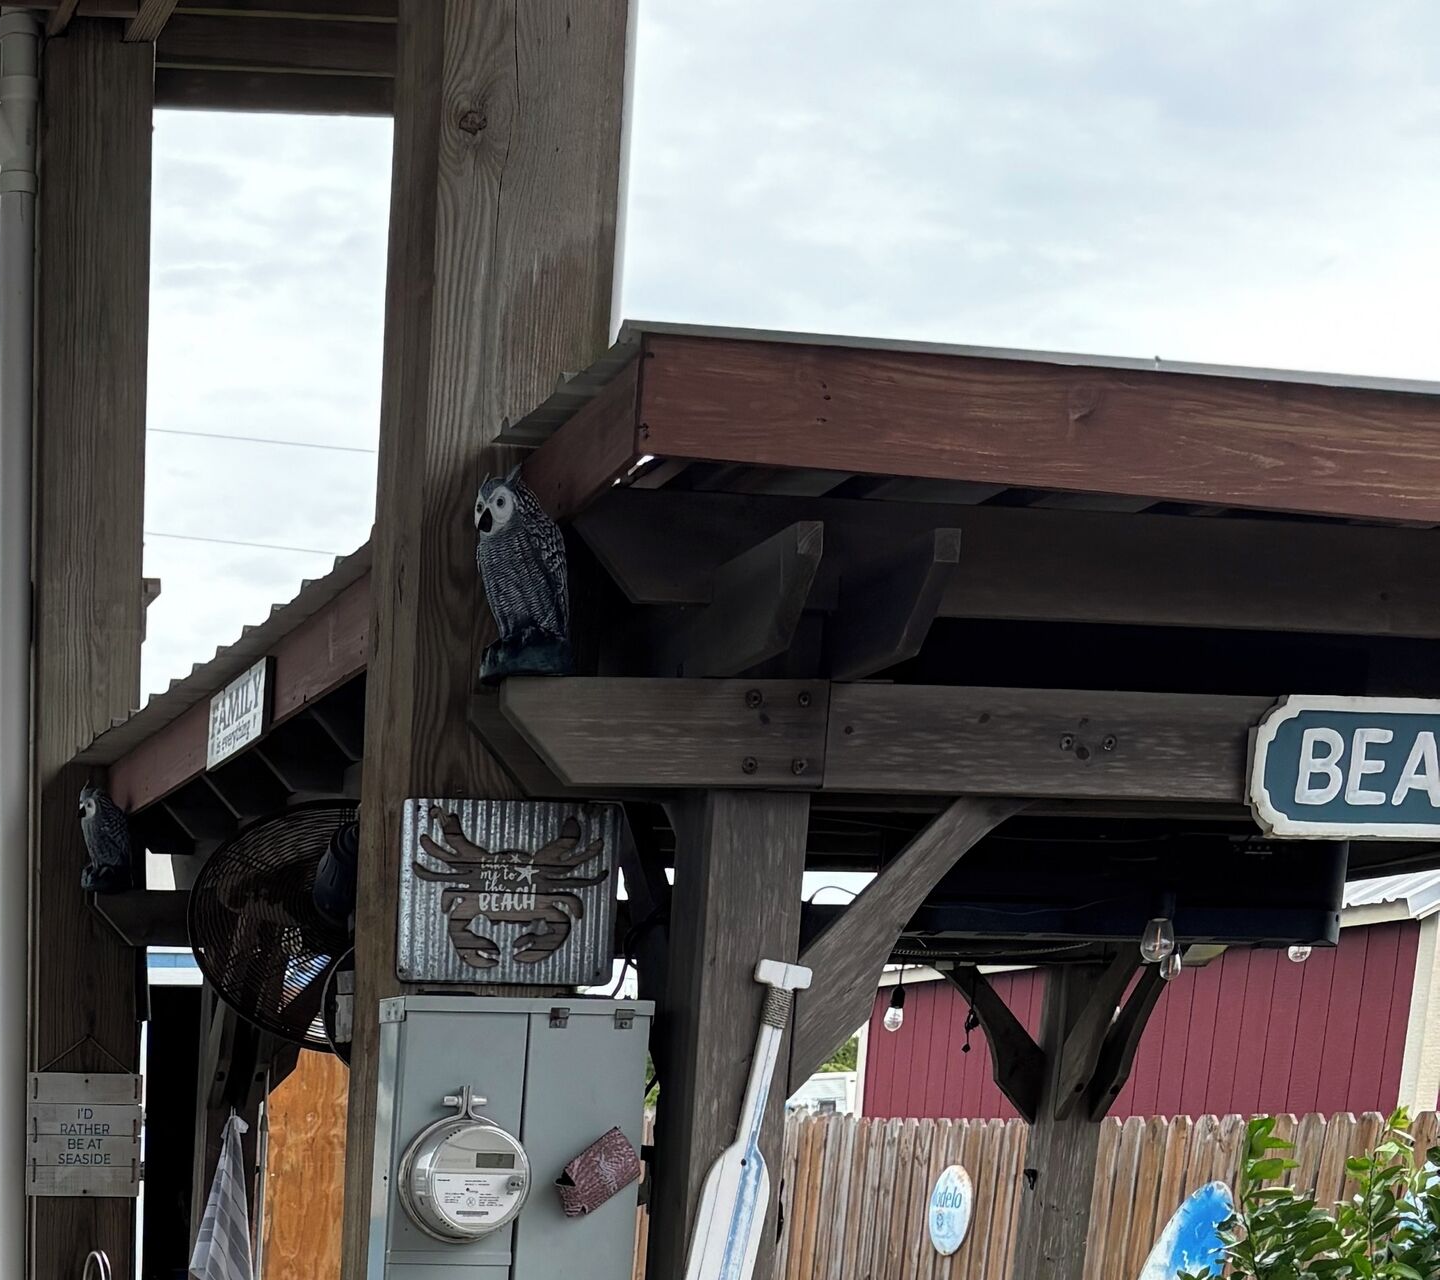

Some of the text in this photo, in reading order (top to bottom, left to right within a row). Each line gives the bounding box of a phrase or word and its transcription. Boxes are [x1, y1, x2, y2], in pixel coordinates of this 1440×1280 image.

[211, 668, 262, 740] FAMILY
[1295, 727, 1440, 807] BEA
[503, 868, 518, 880] to
[485, 880, 507, 892] the
[479, 884, 537, 912] BEACH
[77, 1108, 93, 1119] I'D
[60, 1123, 111, 1135] RATHER
[68, 1138, 104, 1150] BE AT
[58, 1153, 111, 1164] SEASIDE
